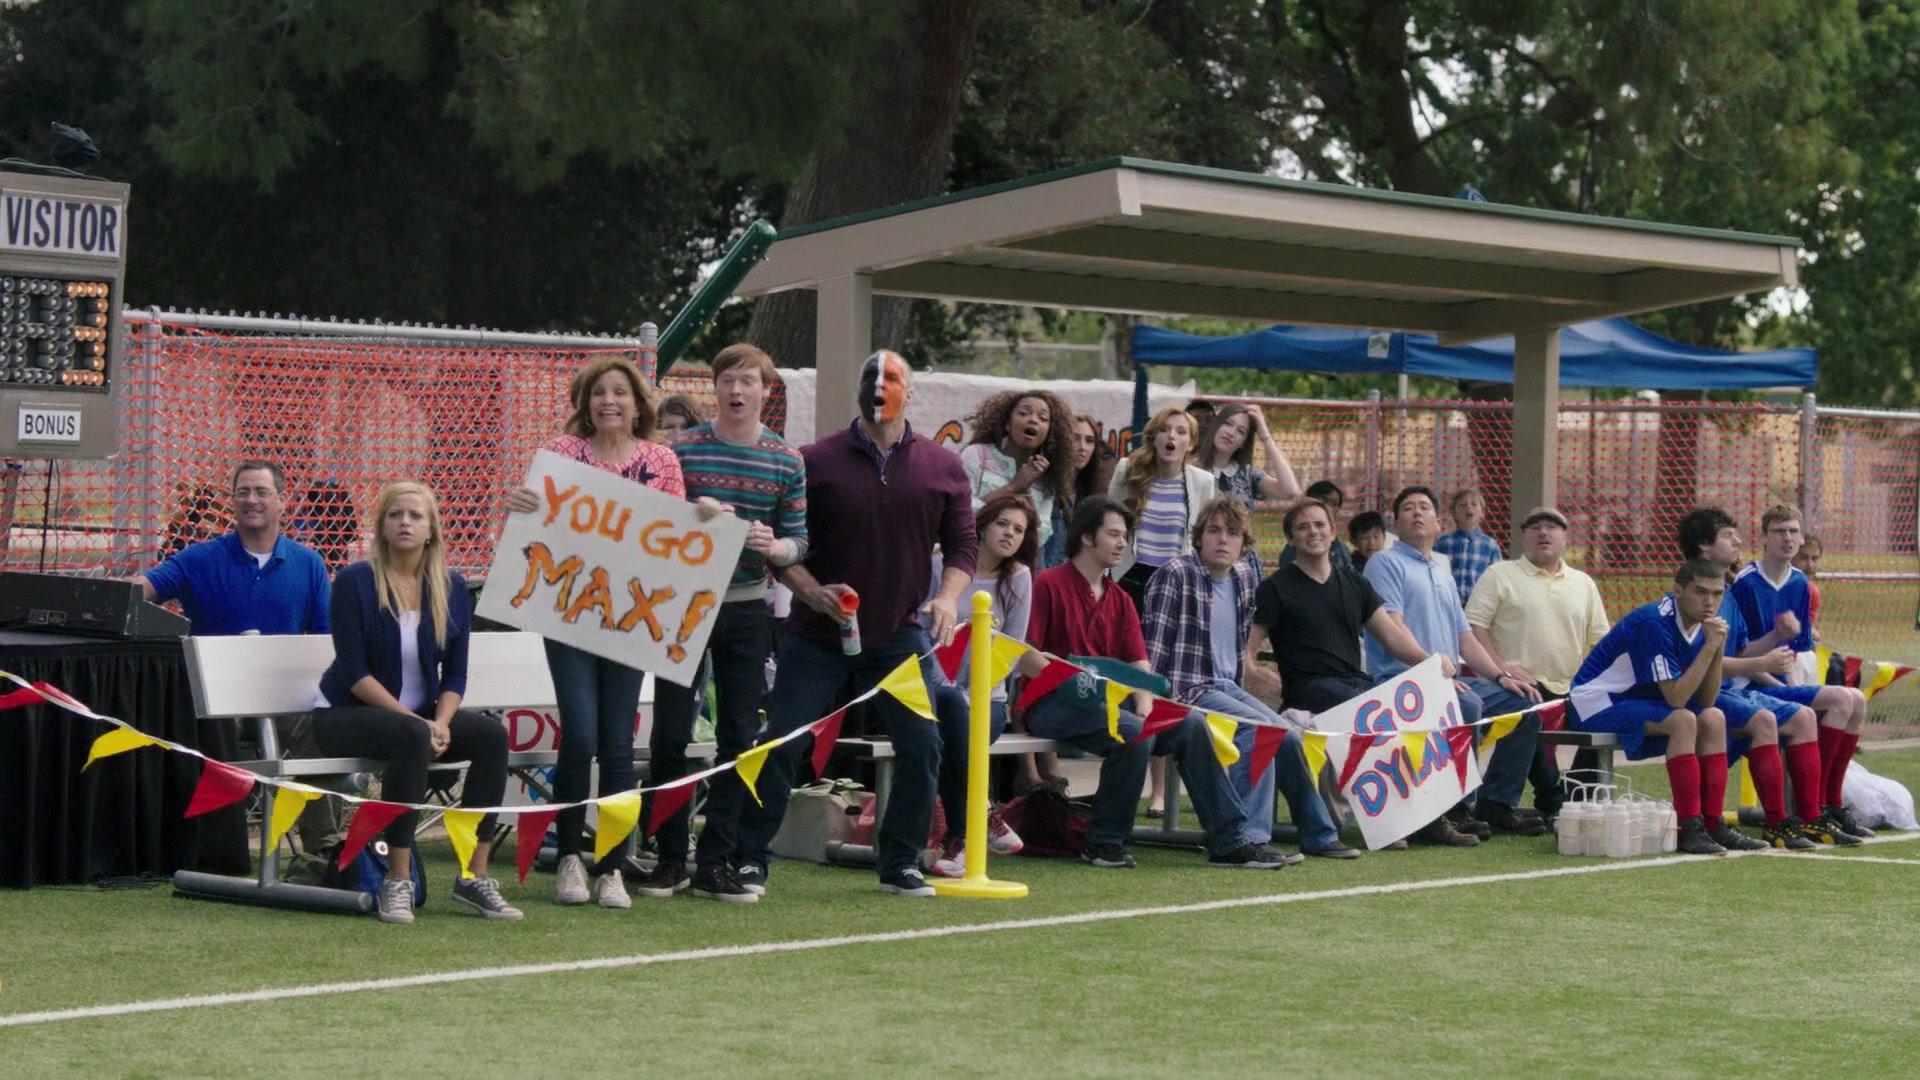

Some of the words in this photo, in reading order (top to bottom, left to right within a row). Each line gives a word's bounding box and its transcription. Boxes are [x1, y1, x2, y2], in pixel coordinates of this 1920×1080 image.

[7, 197, 116, 251] VISITOR
[25, 413, 75, 437] BONUS
[544, 475, 633, 543] YOU
[640, 519, 714, 567] GO
[511, 541, 717, 663] MAX!
[1354, 679, 1424, 747] GO
